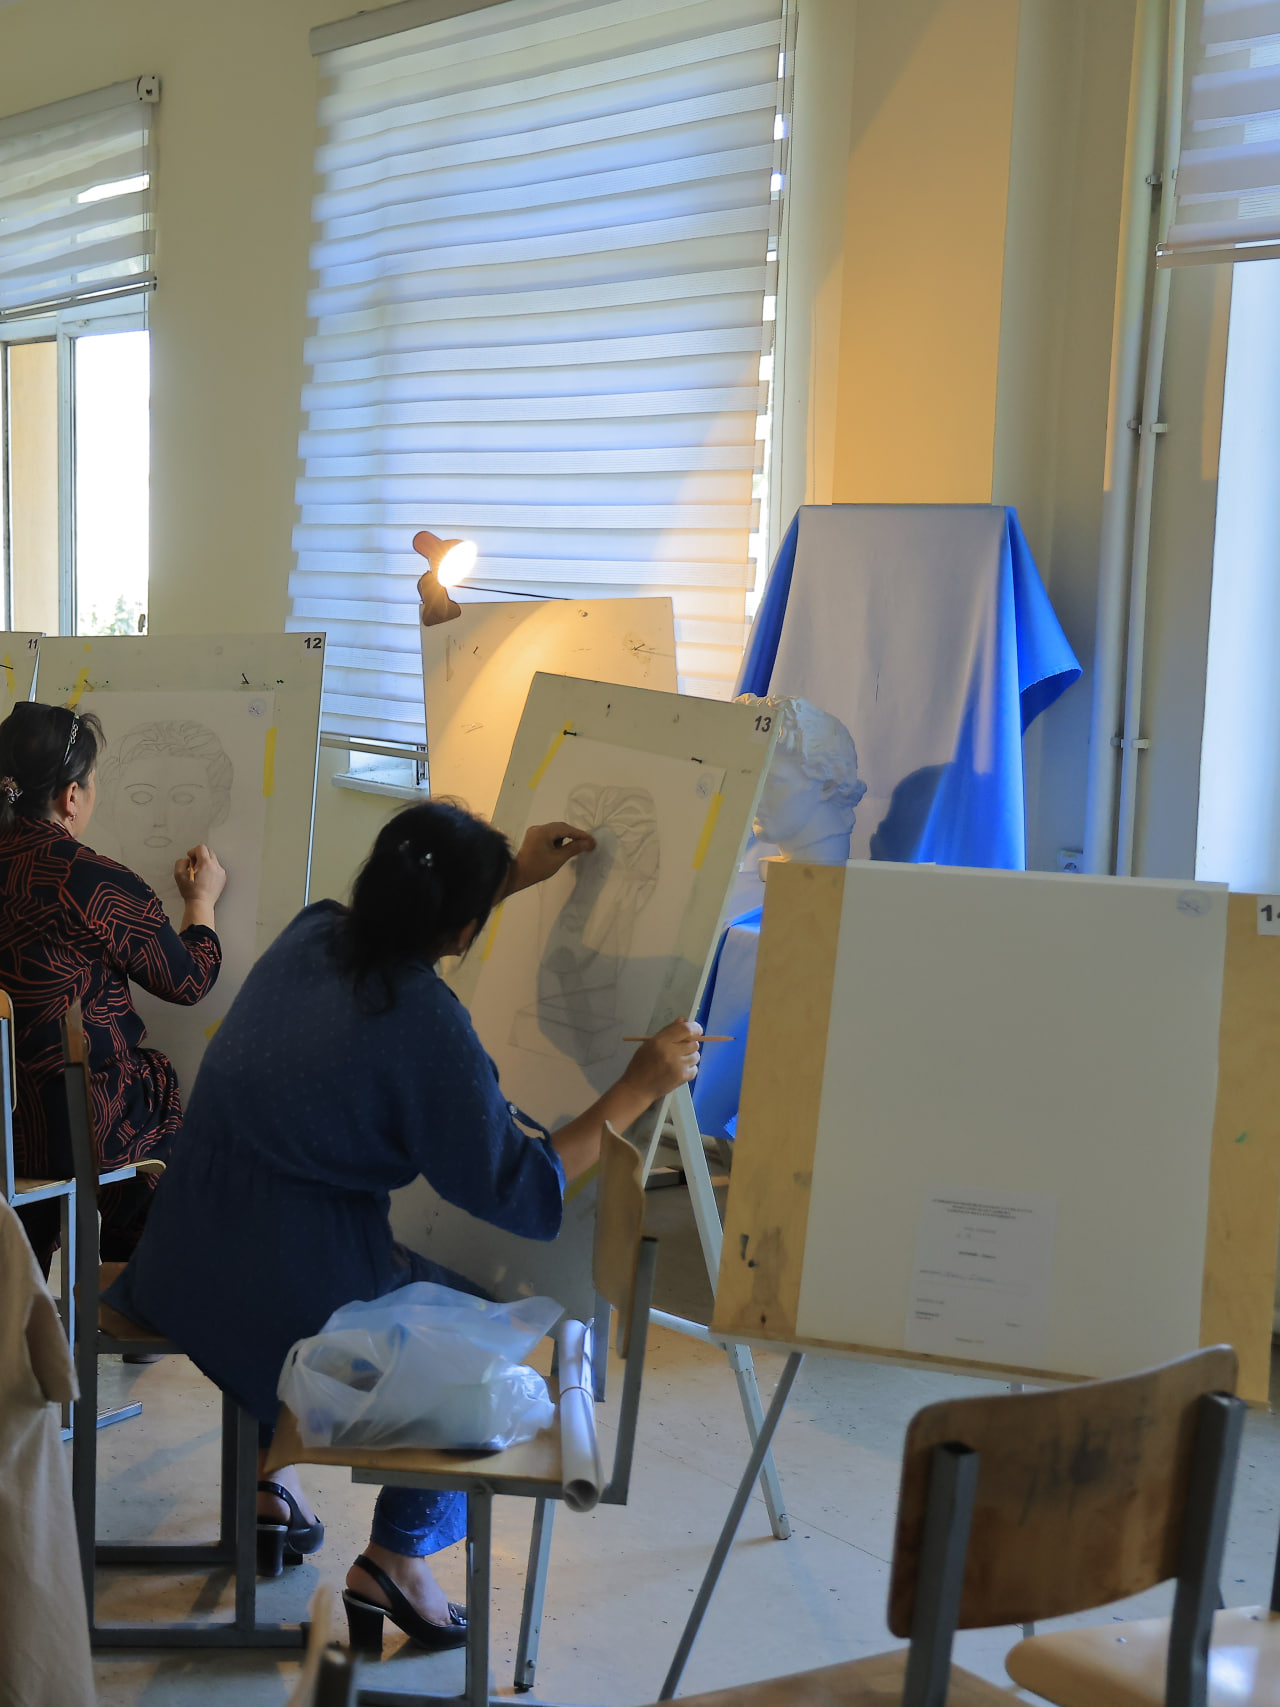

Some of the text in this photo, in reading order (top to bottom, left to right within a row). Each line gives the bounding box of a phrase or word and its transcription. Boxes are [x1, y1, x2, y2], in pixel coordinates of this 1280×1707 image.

[28, 639, 38, 649] 11
[304, 638, 322, 649] 12
[754, 716, 772, 732] 13
[1260, 904, 1280, 922] 1
